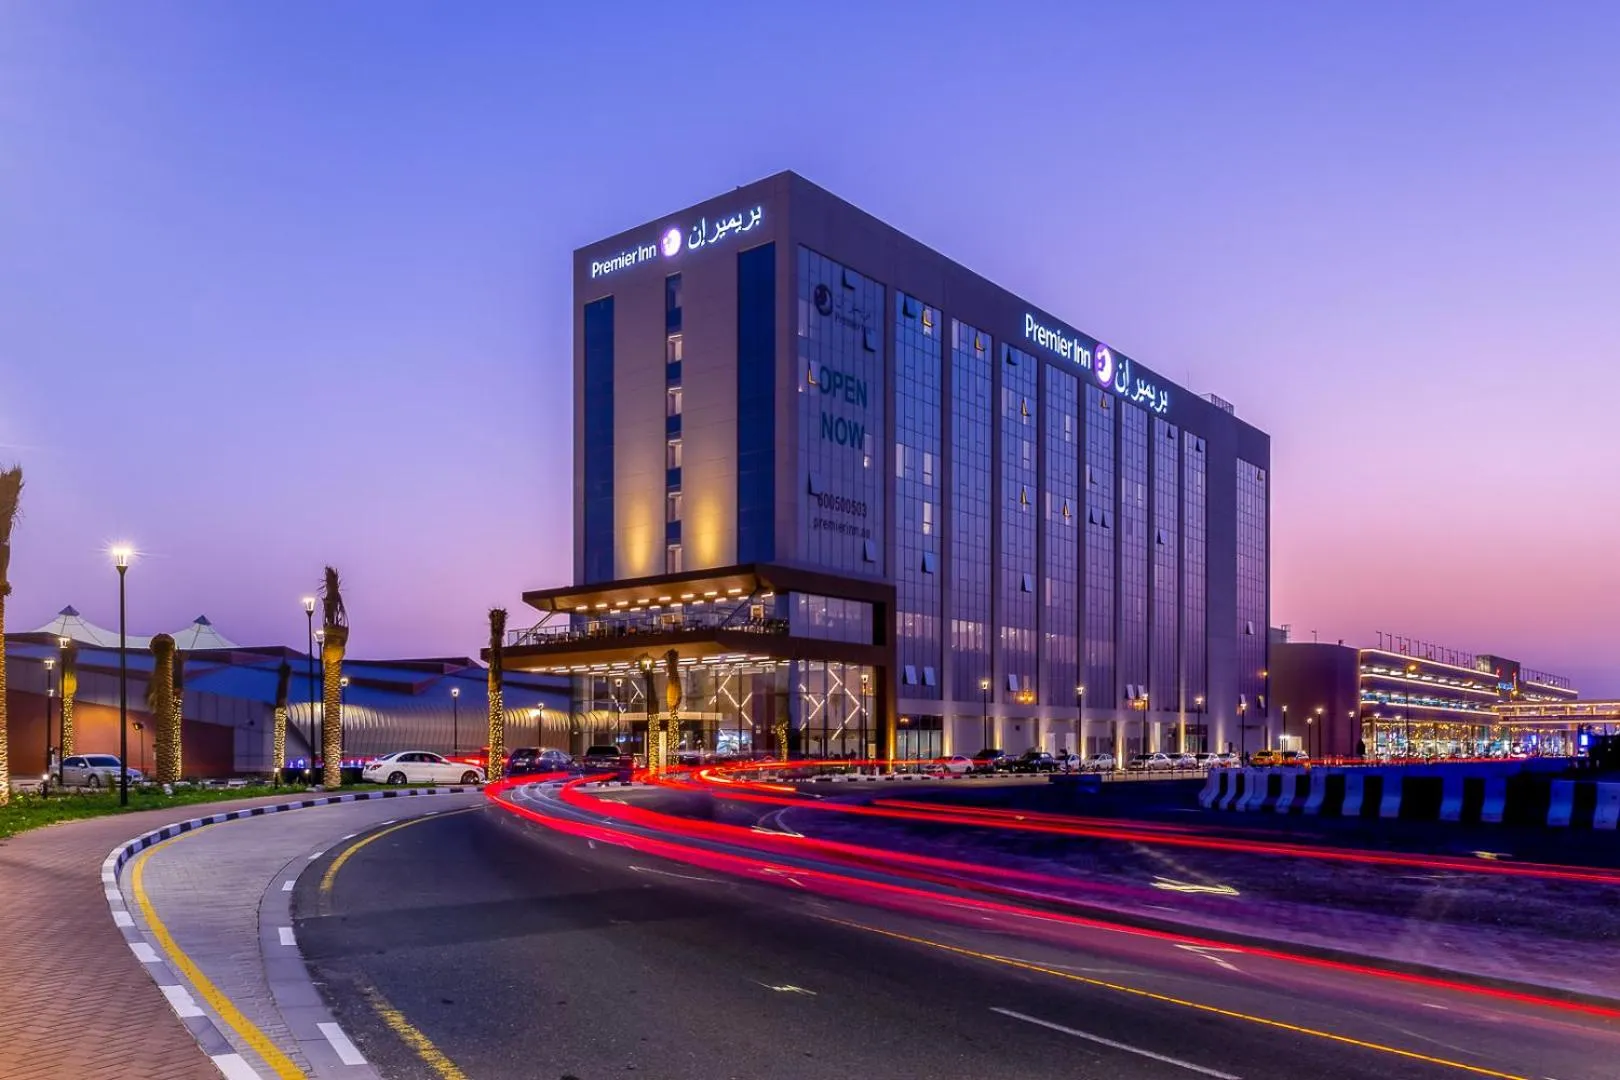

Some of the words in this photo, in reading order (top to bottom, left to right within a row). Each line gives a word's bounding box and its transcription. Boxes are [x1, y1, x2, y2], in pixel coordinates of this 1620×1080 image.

[707, 205, 762, 243] بريمير
[592, 250, 638, 278] Premier
[638, 243, 656, 262] Inn
[1025, 313, 1073, 359] Premier
[1074, 338, 1091, 369] Inn
[819, 365, 868, 410] OPEN
[1131, 377, 1168, 414] بريمير
[821, 411, 866, 450] NOW
